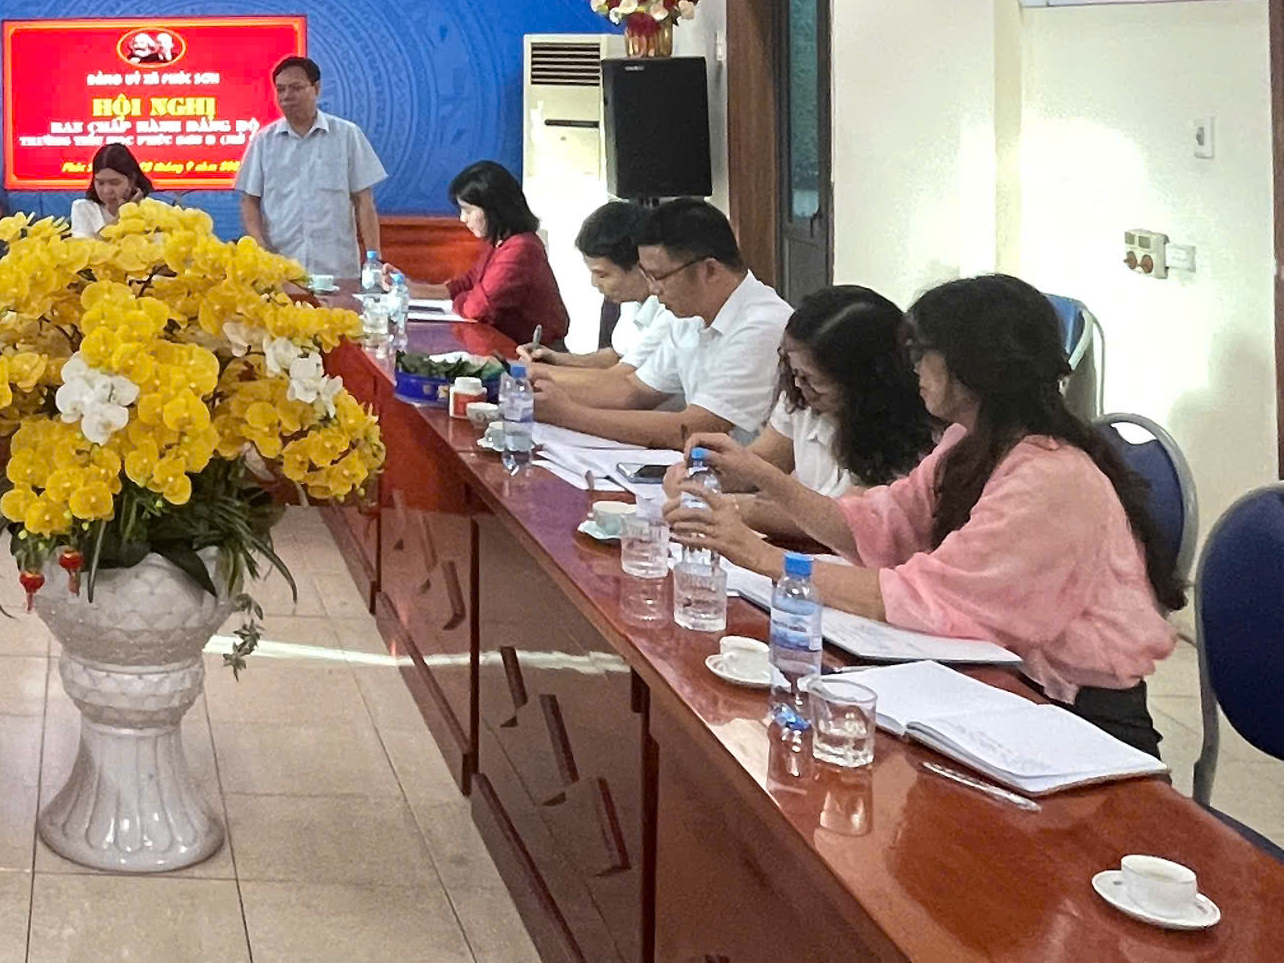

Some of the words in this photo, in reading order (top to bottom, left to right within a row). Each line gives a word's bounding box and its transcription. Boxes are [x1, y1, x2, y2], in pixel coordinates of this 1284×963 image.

[92, 93, 141, 121] HỘI
[150, 97, 216, 121] NGHỊ
[50, 121, 84, 134] BAN
